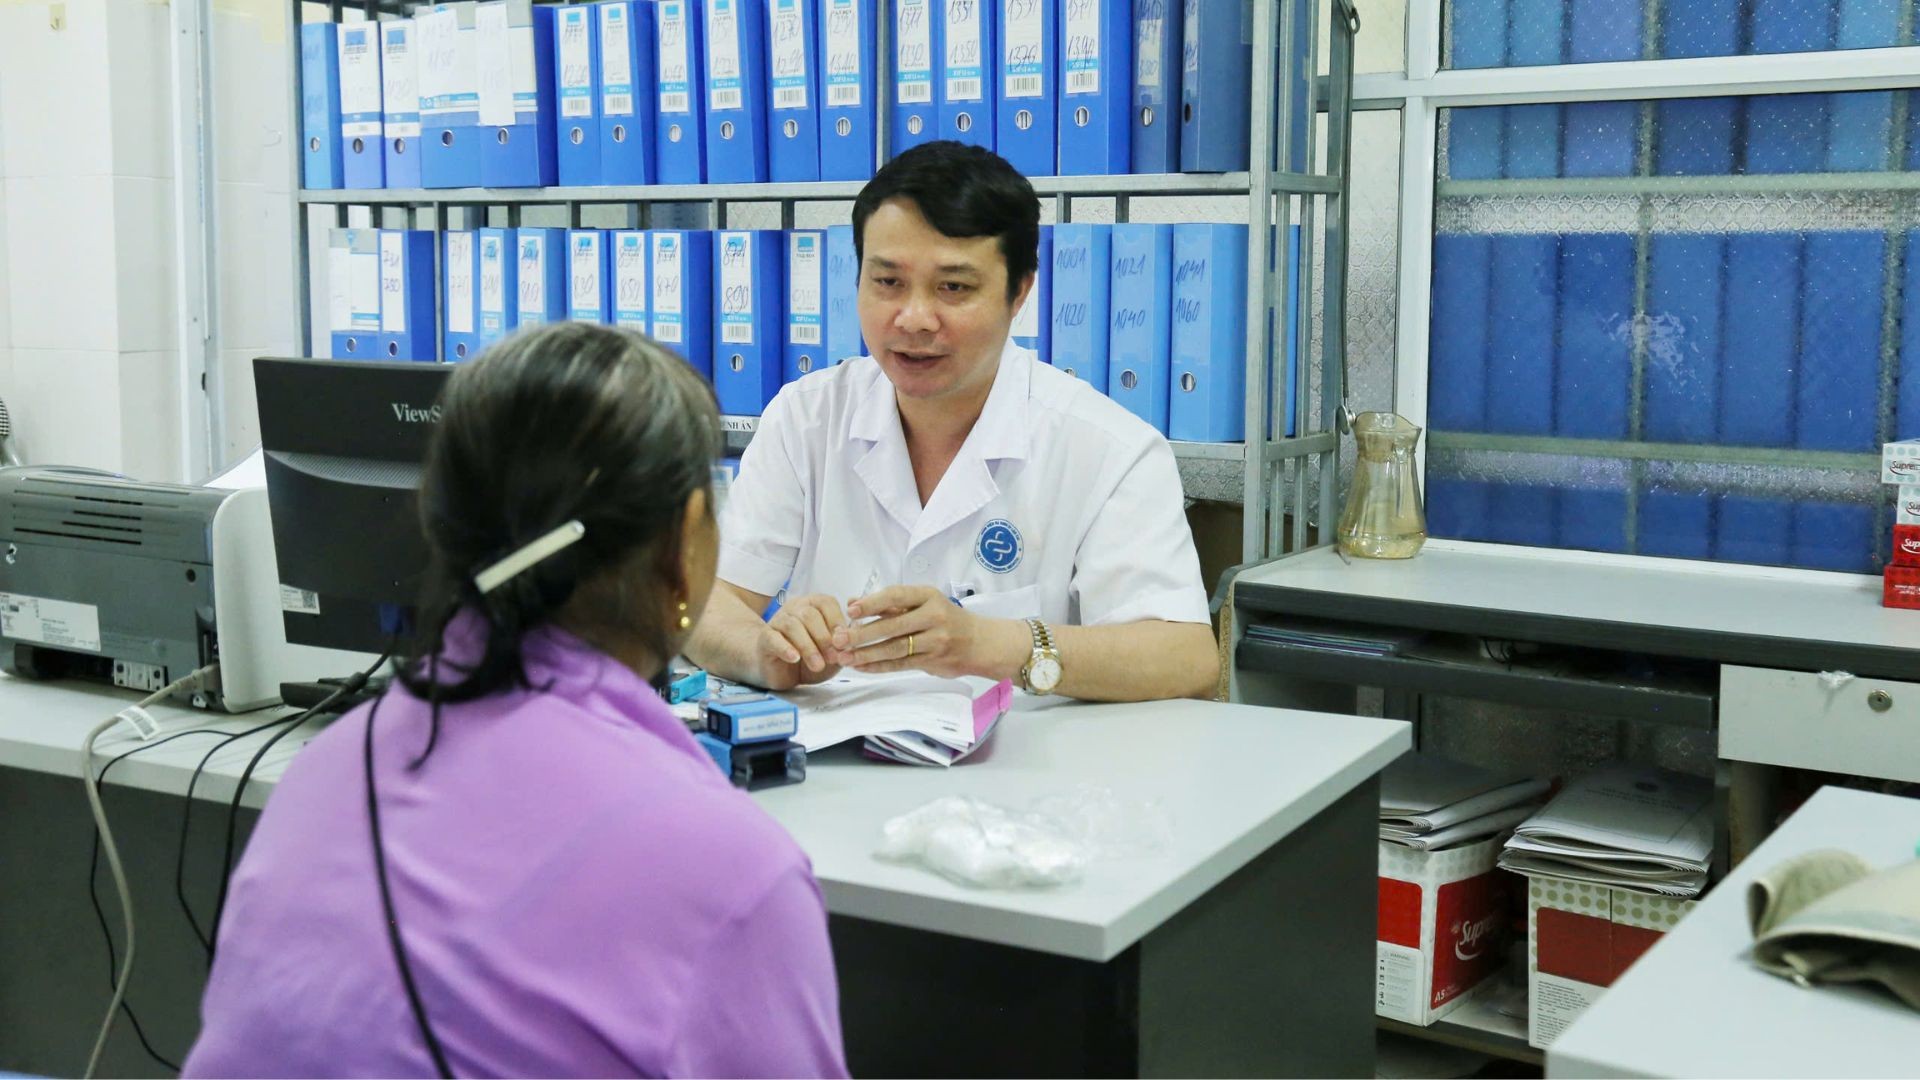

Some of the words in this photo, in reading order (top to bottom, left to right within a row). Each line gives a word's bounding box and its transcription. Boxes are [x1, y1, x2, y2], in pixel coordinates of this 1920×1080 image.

[1056, 248, 1087, 271] 1001
[1114, 254, 1146, 280] 1021
[1175, 258, 1206, 287] 1041
[1056, 303, 1087, 332] 1020
[1114, 308, 1146, 334] 1040
[1175, 296, 1201, 325] 1060
[391, 403, 441, 424] ViewS
